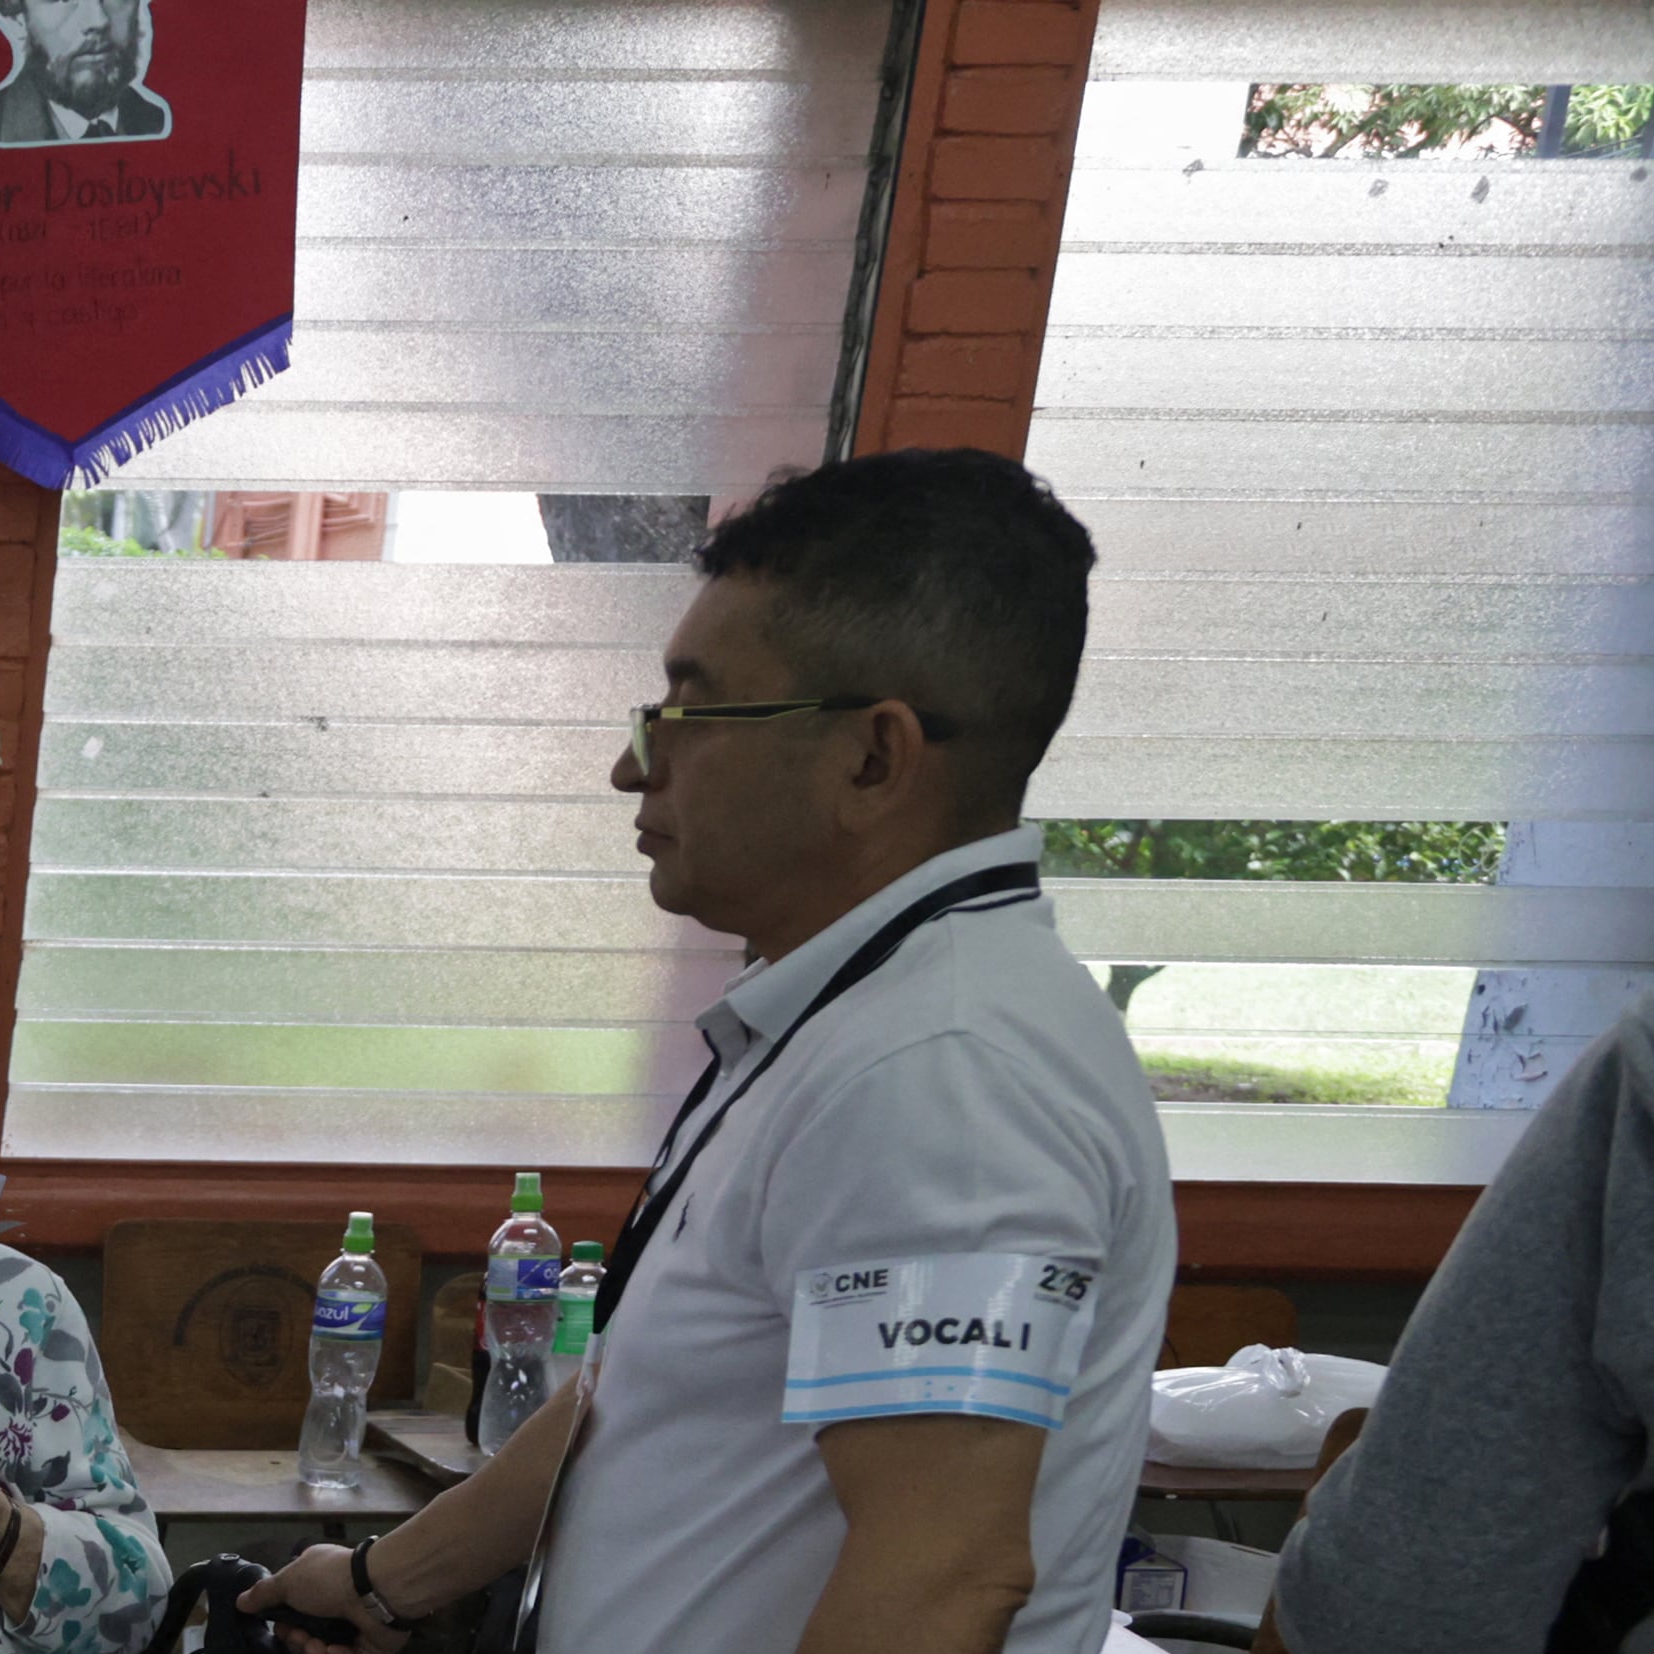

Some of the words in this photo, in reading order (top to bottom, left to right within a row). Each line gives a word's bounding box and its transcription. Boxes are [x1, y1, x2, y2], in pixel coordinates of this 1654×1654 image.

[835, 1268, 890, 1293] CNE
[315, 1305, 349, 1321] azul
[878, 1318, 1012, 1349] VOCAL
